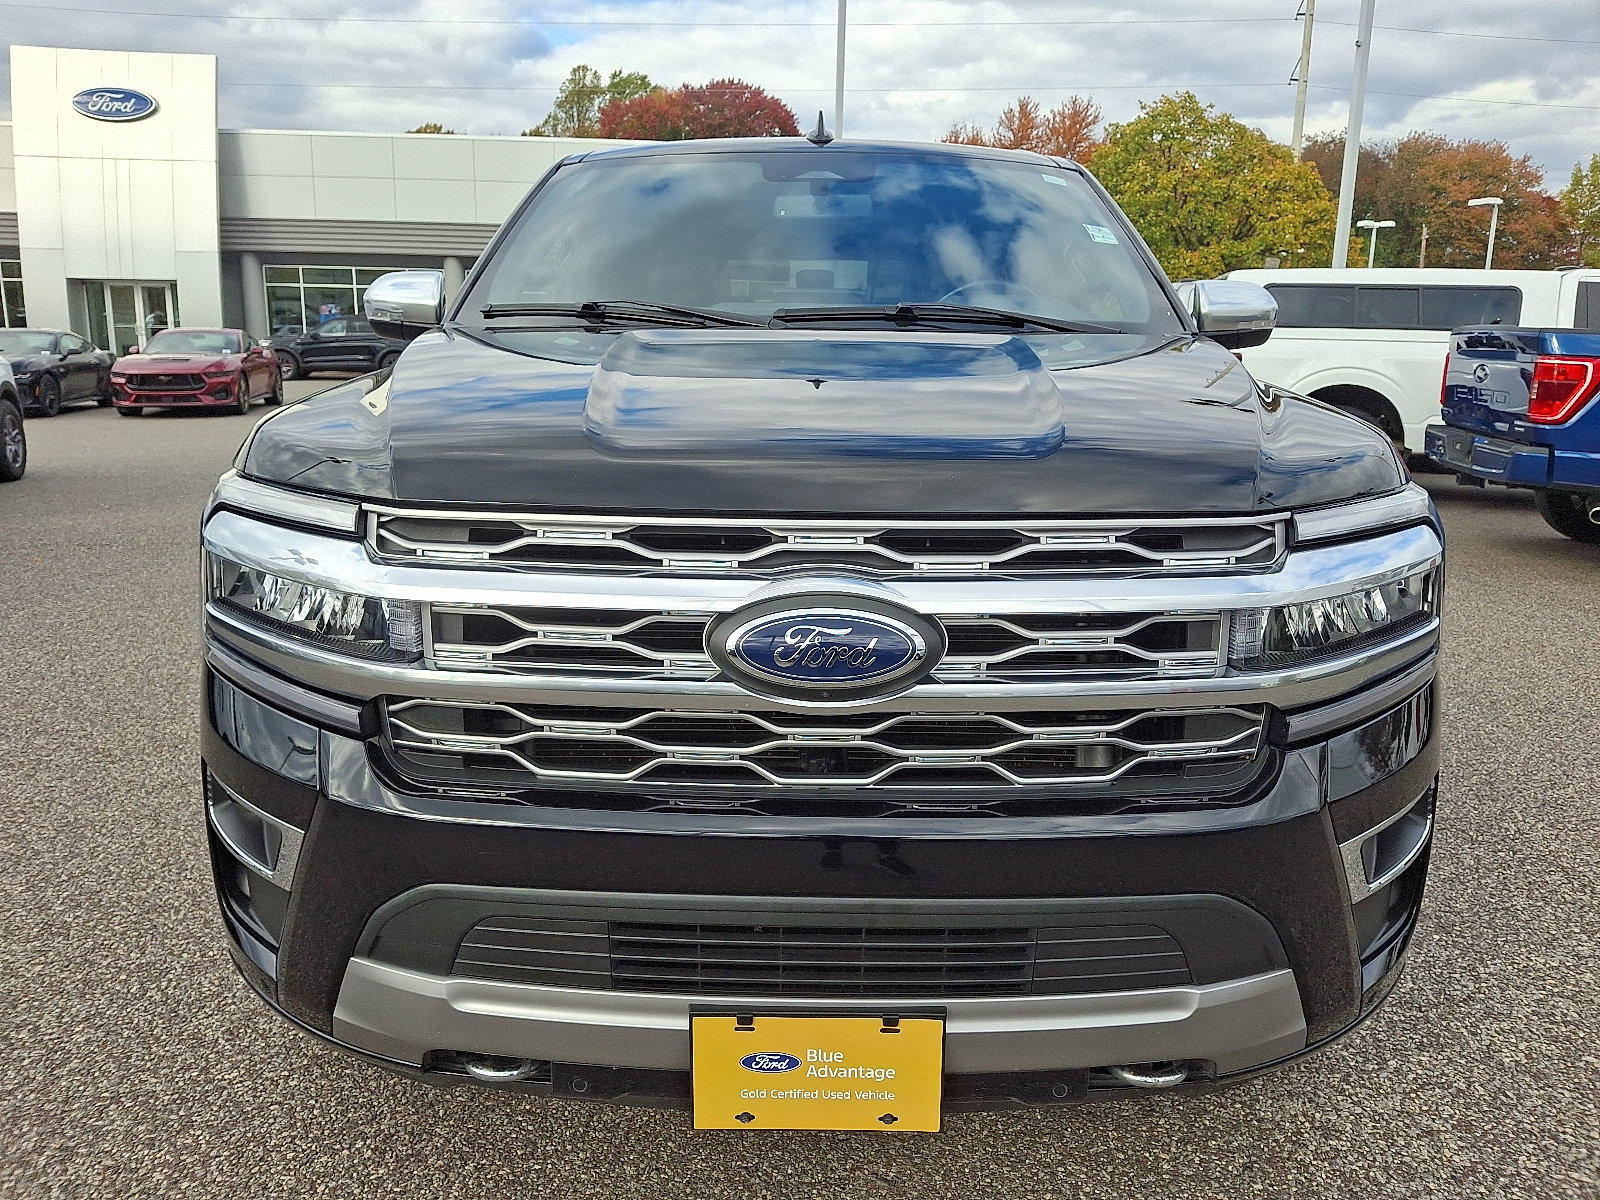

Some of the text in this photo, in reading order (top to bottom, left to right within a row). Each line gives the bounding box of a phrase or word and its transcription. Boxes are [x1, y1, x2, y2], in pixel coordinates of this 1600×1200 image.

[88, 92, 136, 112] Ford
[773, 625, 878, 669] Ford
[751, 1055, 789, 1070] Ford
[806, 1049, 844, 1063] Blue
[806, 1065, 896, 1082] Advantage
[740, 1089, 895, 1100] Gold Certified Used Vehicle
